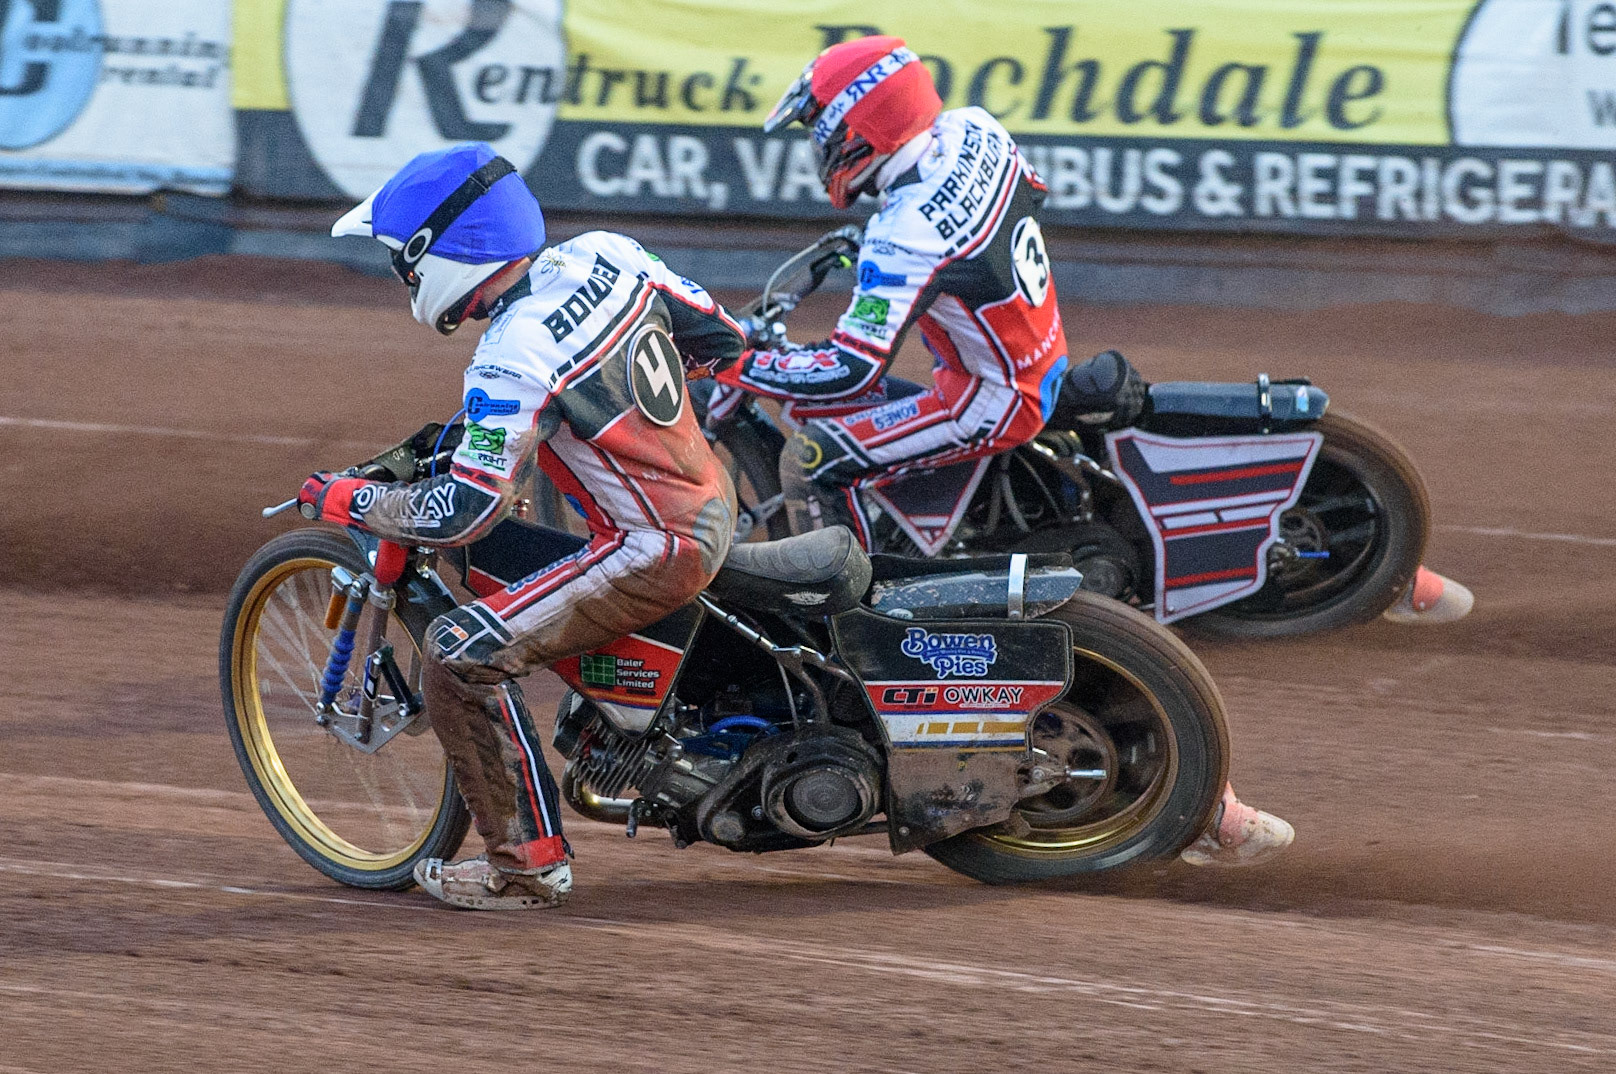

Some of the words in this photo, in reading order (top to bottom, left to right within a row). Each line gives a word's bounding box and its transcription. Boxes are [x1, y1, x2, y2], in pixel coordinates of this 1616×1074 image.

[811, 24, 1386, 131] chdale
[576, 130, 728, 210] CAR,
[733, 136, 834, 200] VA
[1193, 149, 1245, 217] &
[917, 119, 983, 222] PARKINSON
[935, 129, 1004, 241] BLACKBURN
[1025, 236, 1048, 290] 3
[635, 331, 679, 407] 4
[616, 658, 644, 667] Baler
[902, 627, 997, 658] Bowen
[616, 668, 660, 679] Services
[616, 678, 655, 689] Limited
[931, 656, 989, 680] Pies
[943, 686, 1024, 704] OWKAY
